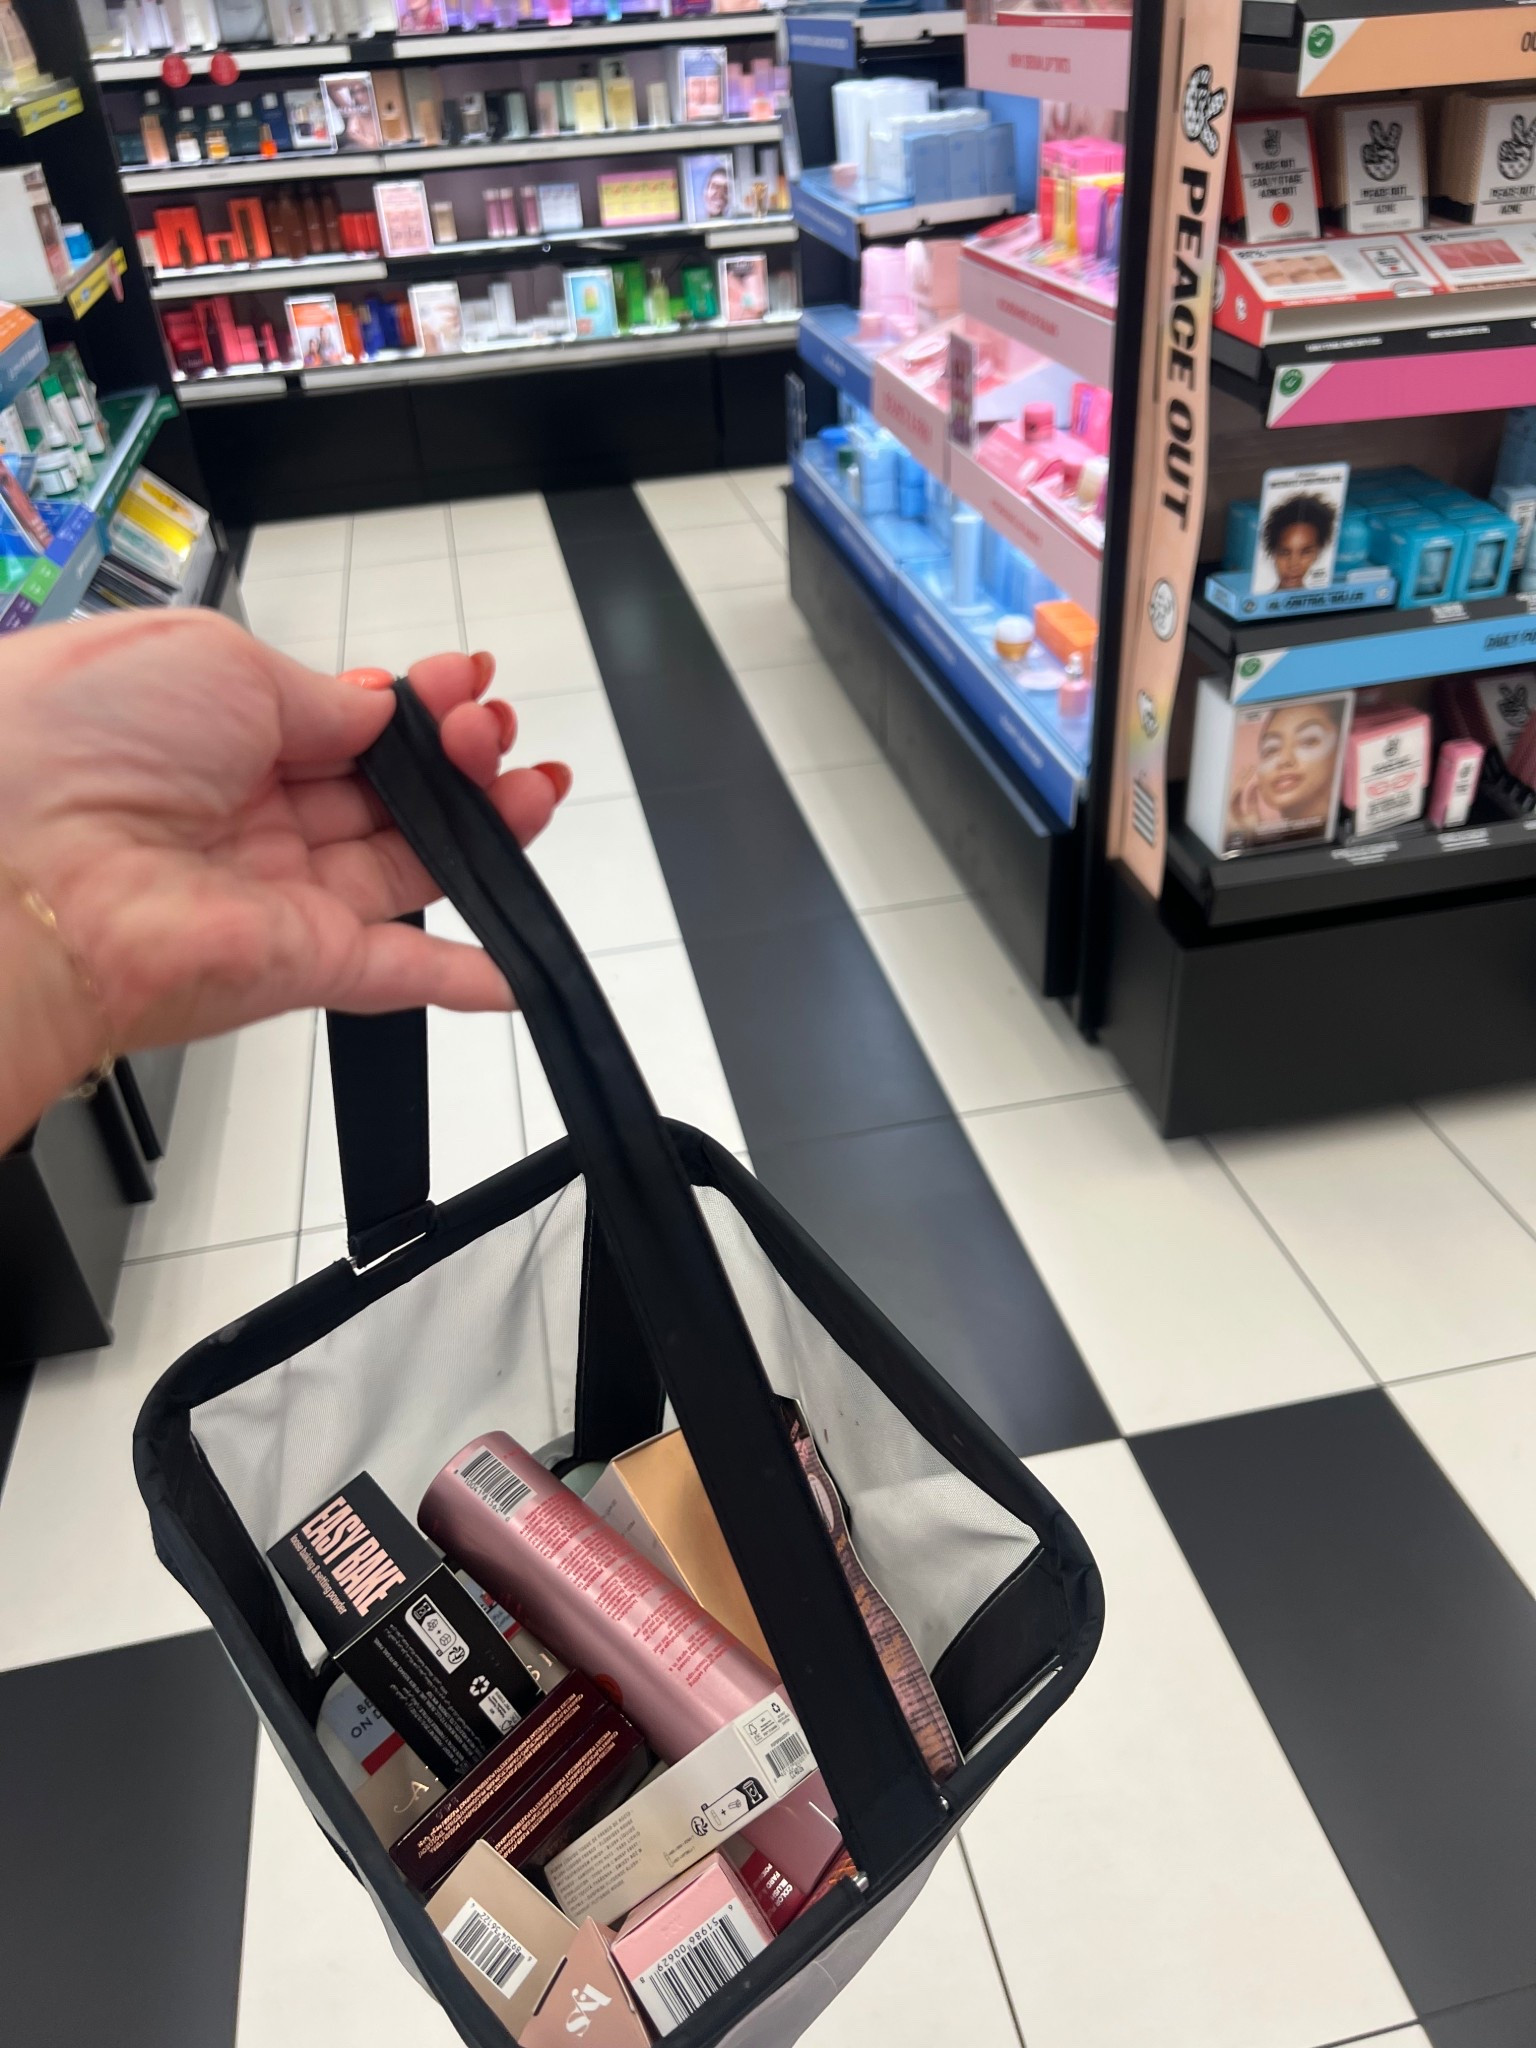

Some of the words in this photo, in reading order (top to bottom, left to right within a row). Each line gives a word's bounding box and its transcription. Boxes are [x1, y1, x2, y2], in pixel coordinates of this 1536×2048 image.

[1167, 167, 1210, 393] PEACE
[1160, 399, 1193, 532] OUT
[462, 1475, 484, 1498] 10041
[301, 1495, 370, 1565] EASY
[289, 1533, 306, 1552] loose
[296, 1547, 318, 1571] baking
[310, 1565, 321, 1574] &
[312, 1570, 334, 1595] setting
[330, 1536, 406, 1617] BAKE
[324, 1589, 348, 1616] powder
[348, 1716, 373, 1739] ON
[765, 1870, 780, 1889] FARD
[726, 1903, 734, 1911] 6
[774, 1883, 793, 1907] COLOR
[478, 1911, 501, 1934] 36122
[687, 1917, 720, 1945] 51986
[499, 1931, 522, 1954] 89304
[654, 1943, 688, 1972] 00629
[638, 1976, 646, 1984] 8
